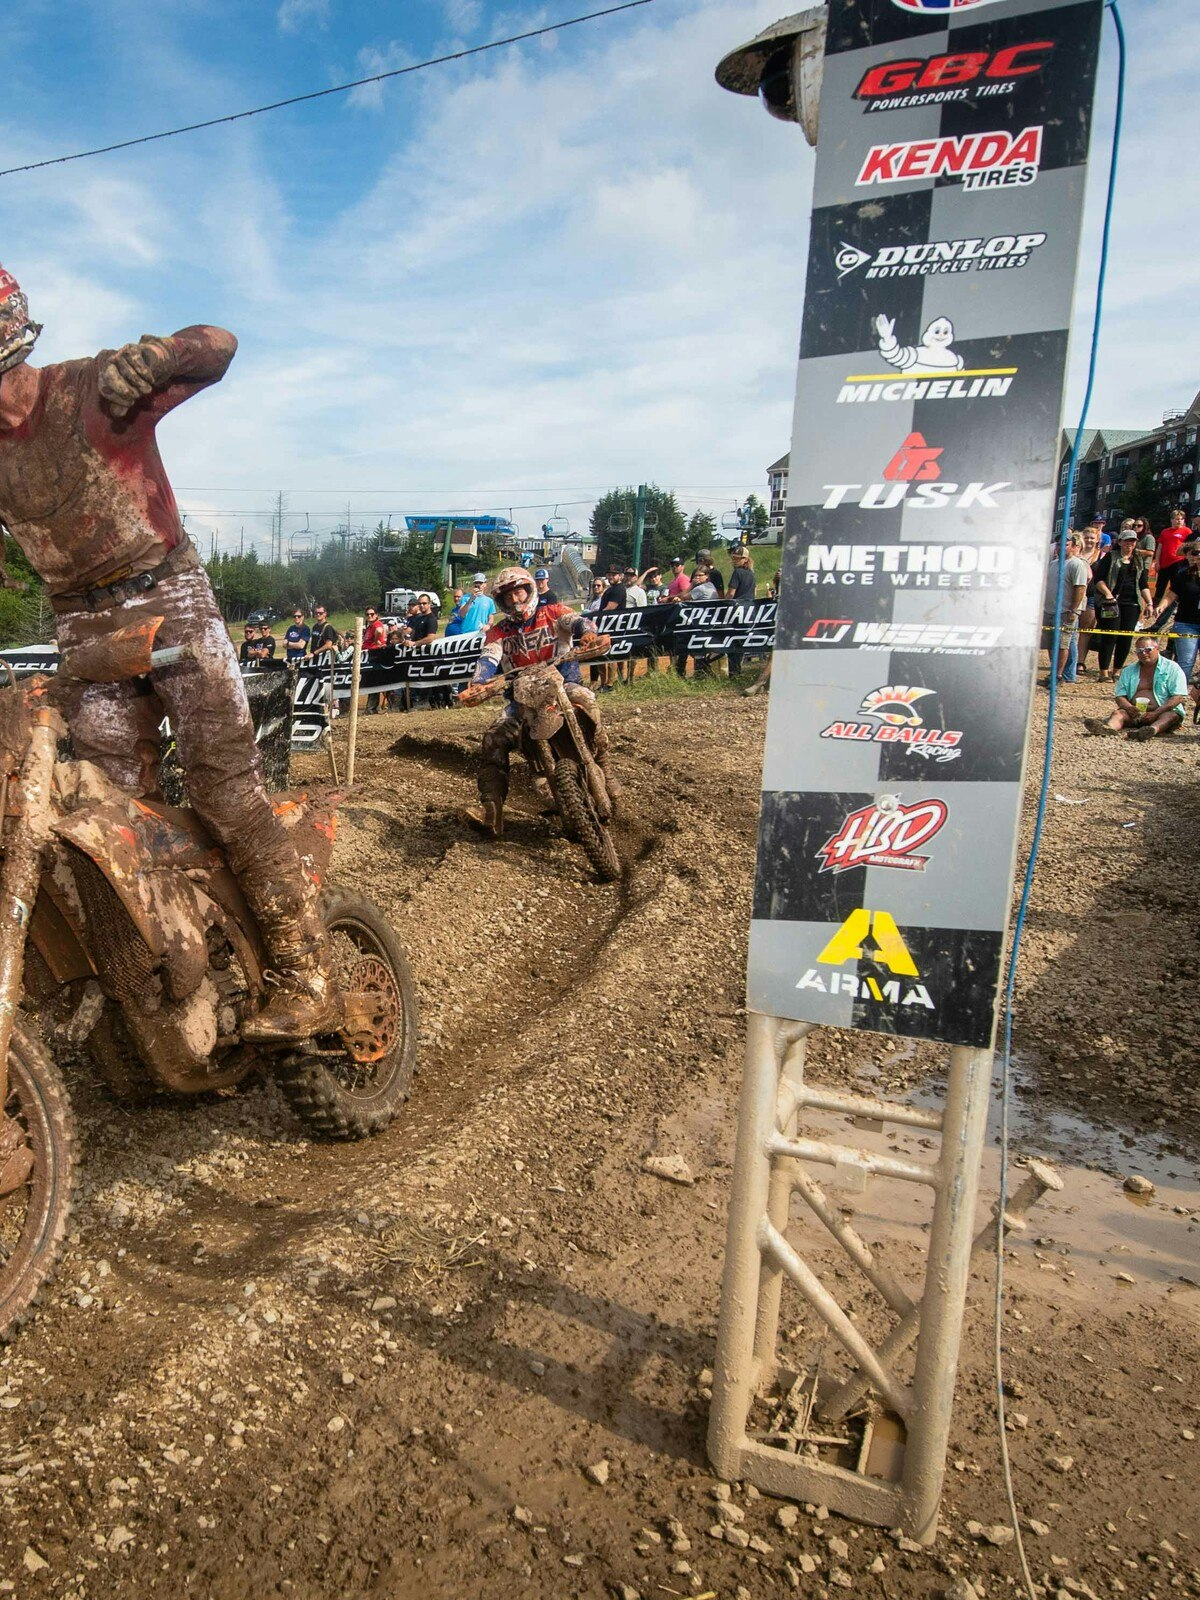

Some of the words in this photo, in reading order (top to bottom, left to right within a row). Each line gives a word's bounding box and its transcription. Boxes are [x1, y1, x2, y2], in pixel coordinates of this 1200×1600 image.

[856, 41, 1054, 98] GBC
[869, 87, 968, 112] POWERSPORTS
[975, 81, 1016, 97] TIRES
[856, 127, 1042, 185] KENDA
[964, 165, 1037, 191] TIRES
[871, 233, 1047, 268] DUNLOP
[865, 257, 970, 280] MOTORCYCLE
[978, 254, 1029, 270] TIRES
[836, 377, 1014, 404] MICHELIN
[821, 482, 1013, 510] TUSK
[806, 544, 1016, 573] METHOD
[805, 572, 874, 585] RACE
[890, 573, 1014, 587] WHEELS
[675, 603, 777, 627] SPECIALIZ
[821, 721, 873, 741] ALL
[874, 725, 963, 748] BALLS
[905, 741, 962, 763] Racing
[795, 968, 936, 1010] ARMA
